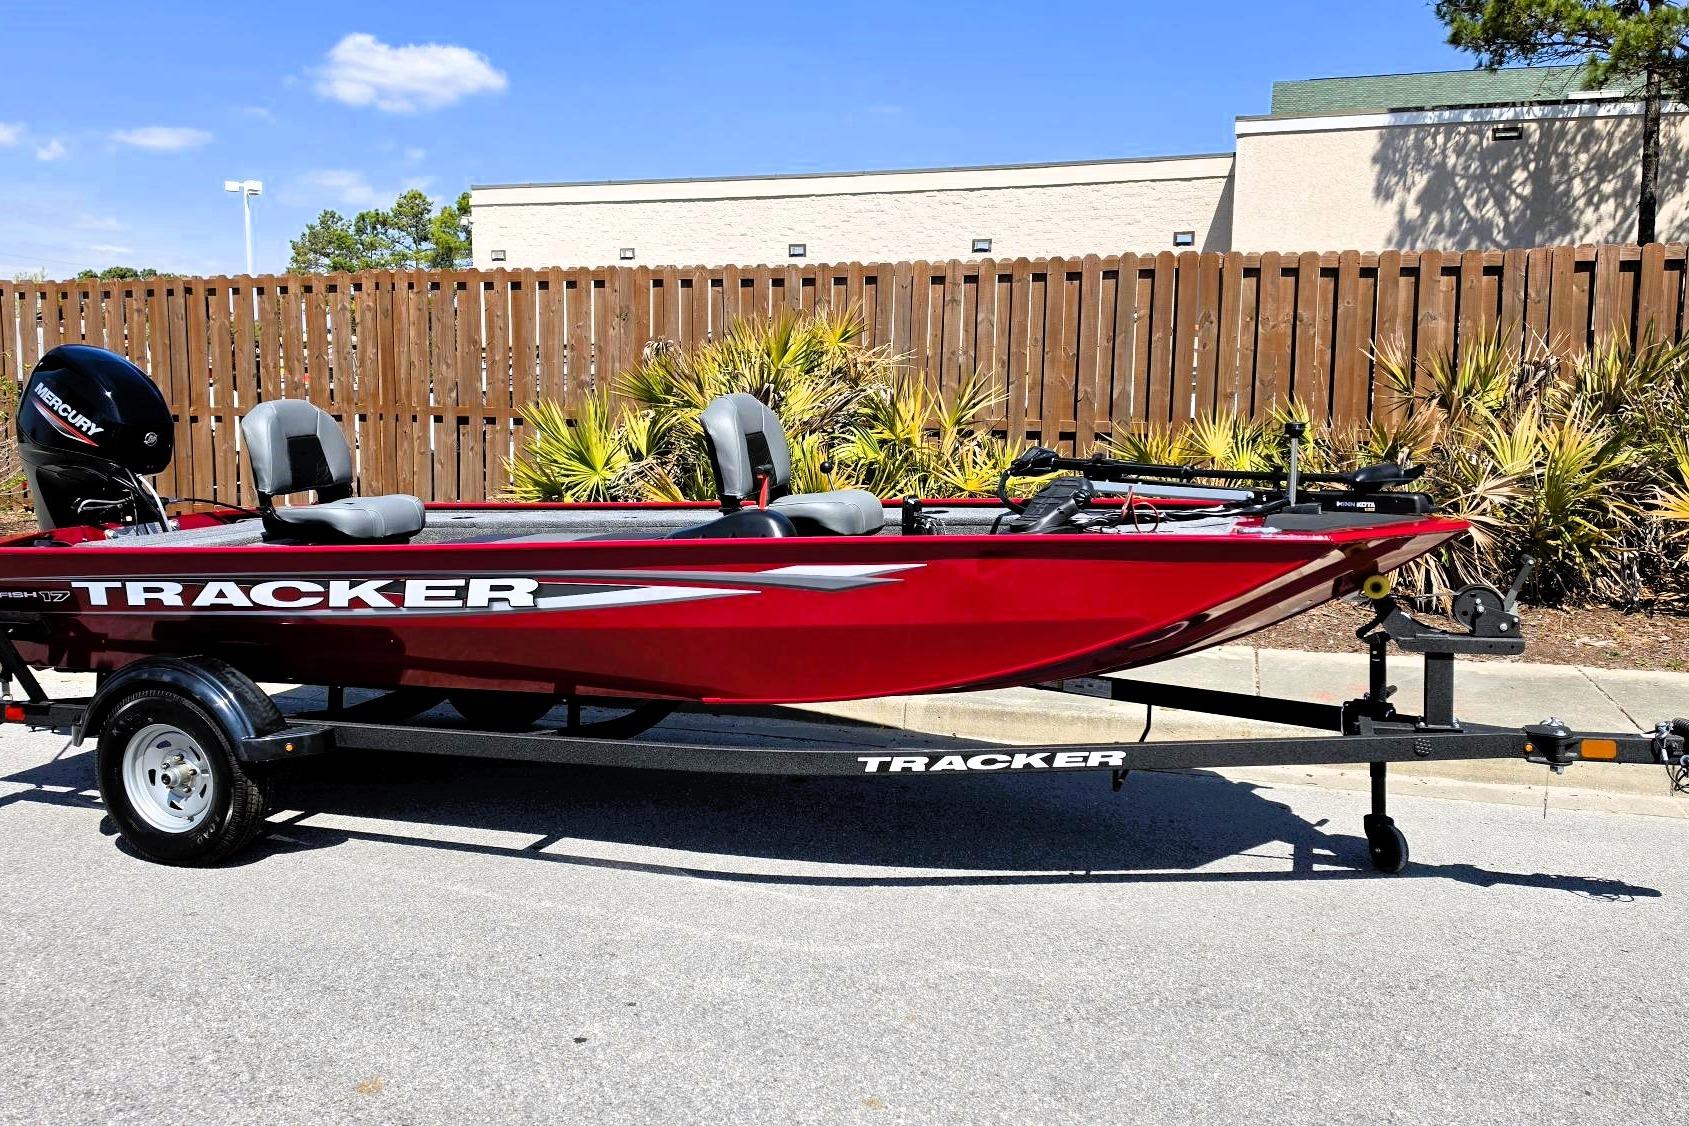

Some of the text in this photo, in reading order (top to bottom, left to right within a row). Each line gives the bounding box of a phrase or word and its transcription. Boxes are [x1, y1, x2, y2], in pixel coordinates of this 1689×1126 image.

[34, 382, 104, 436] MERCURY
[38, 590, 71, 602] 17
[71, 577, 540, 609] TRACKER
[858, 751, 1127, 773] TRACKER
